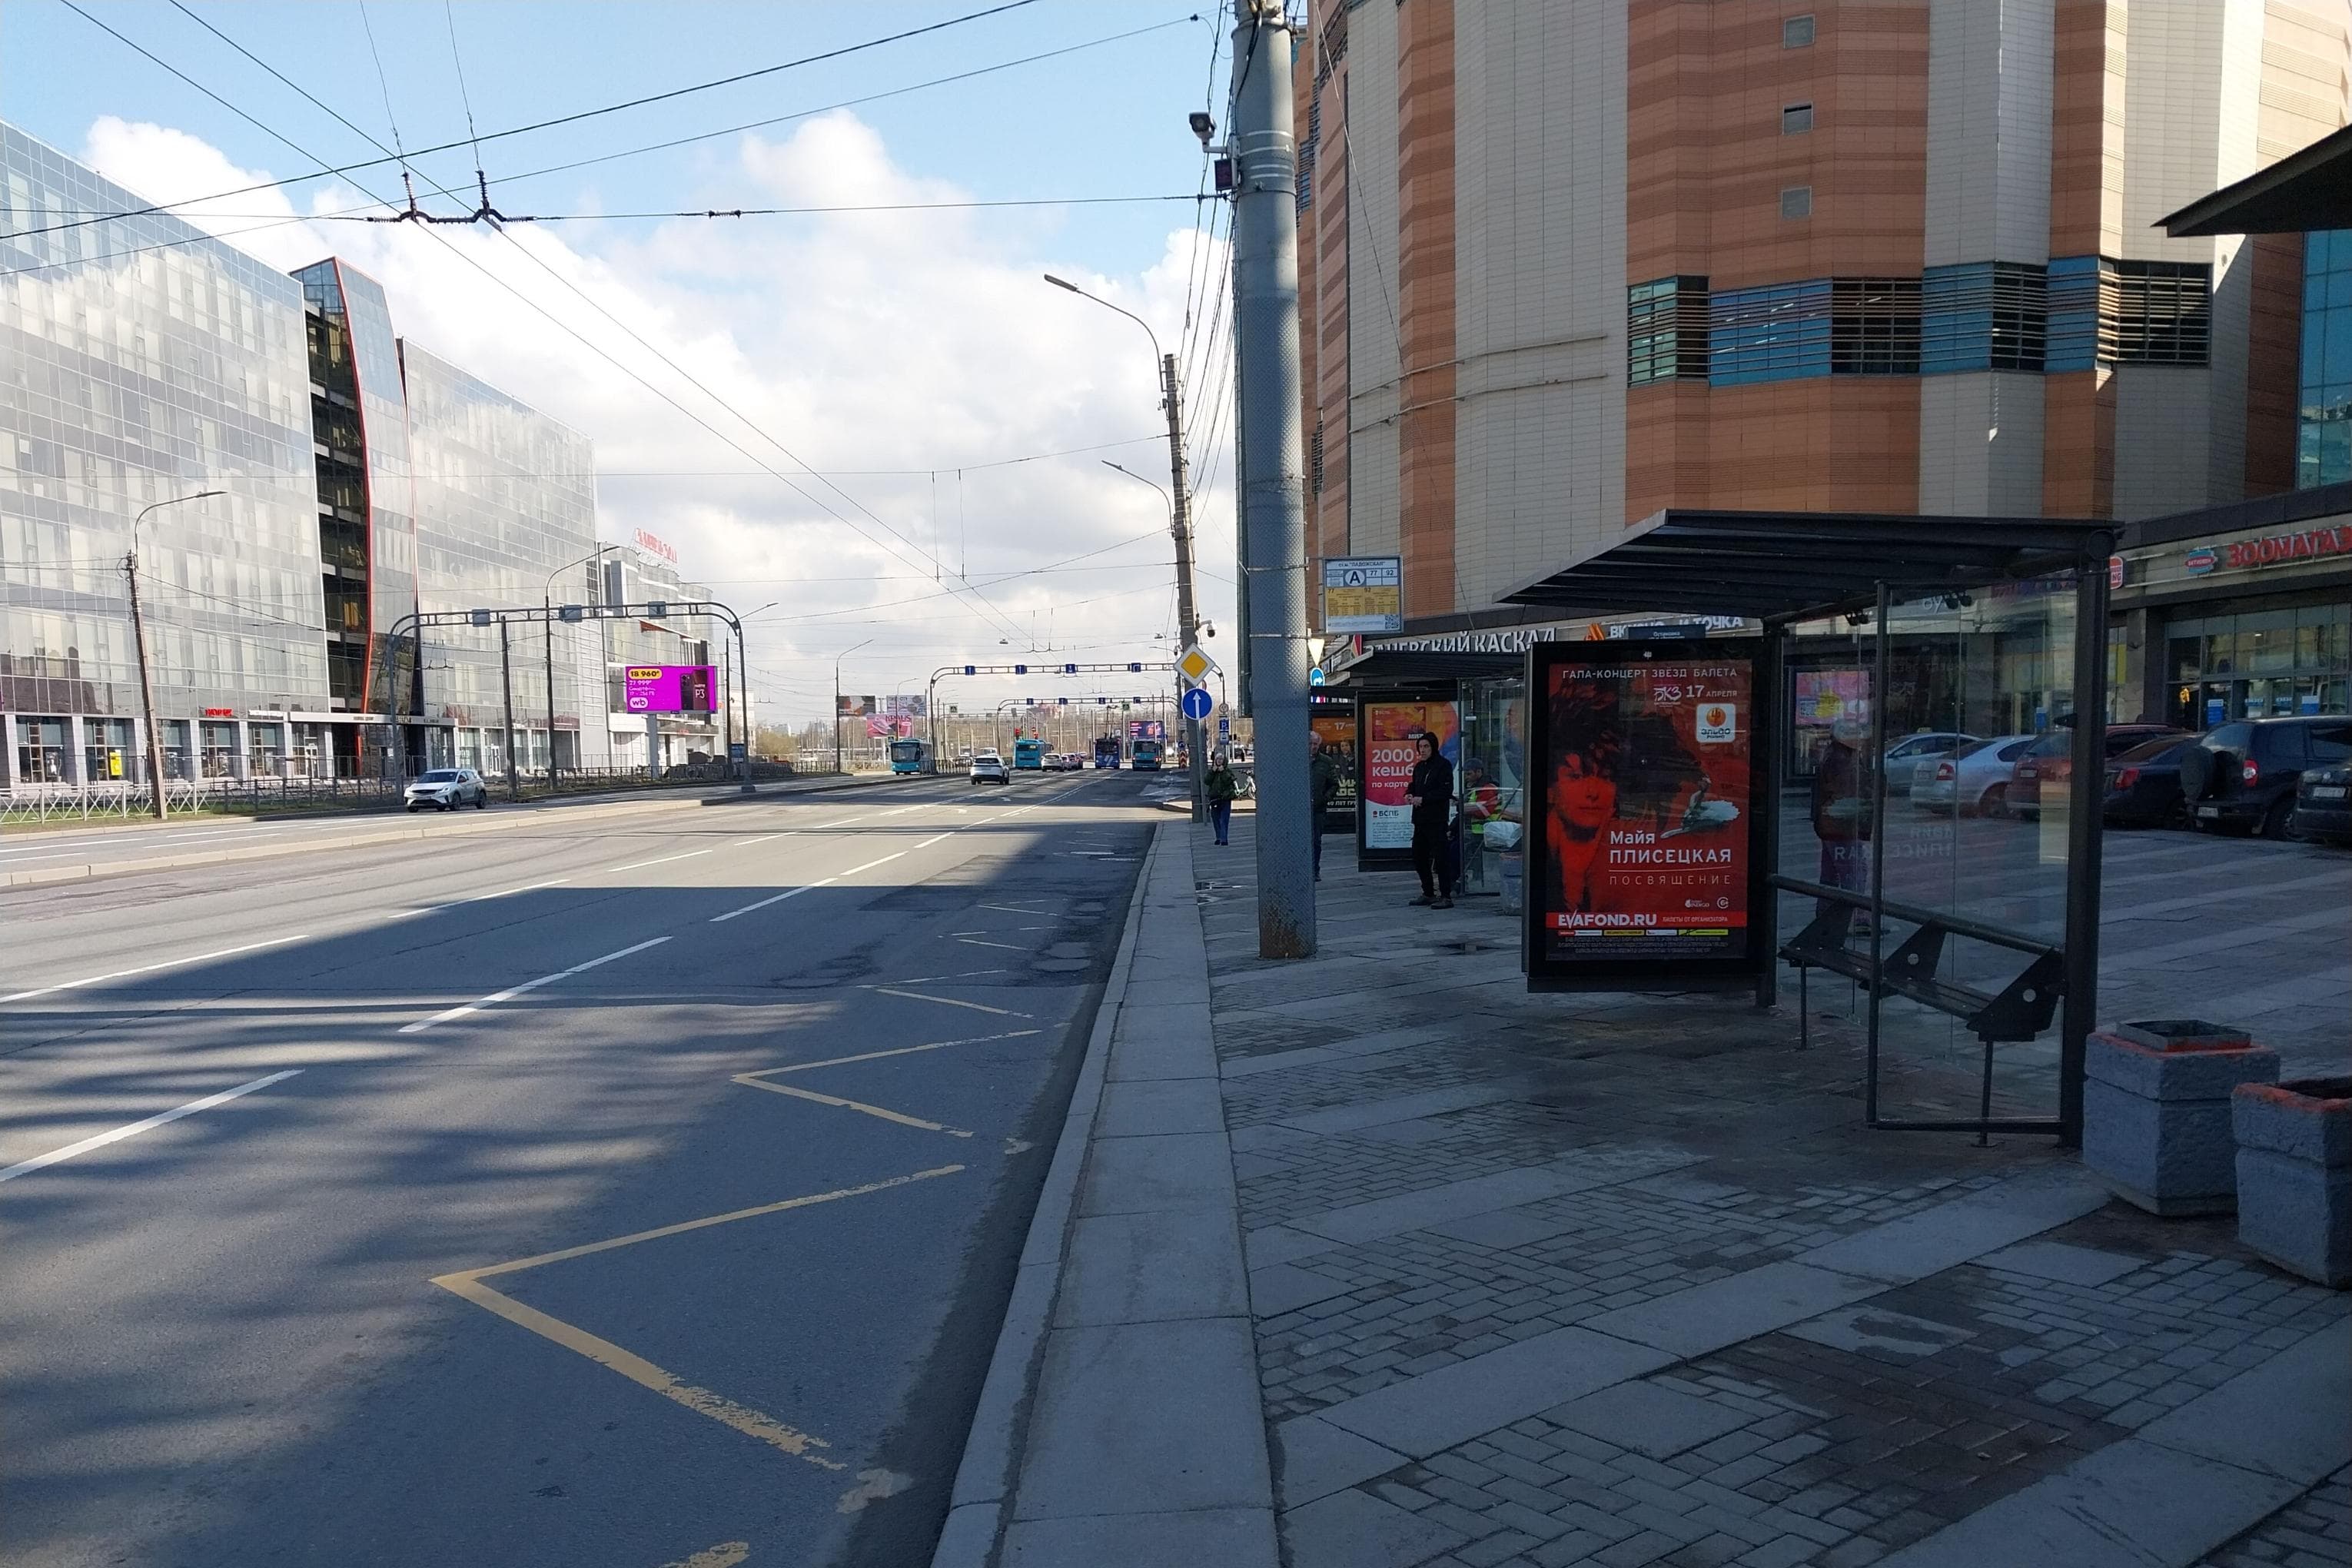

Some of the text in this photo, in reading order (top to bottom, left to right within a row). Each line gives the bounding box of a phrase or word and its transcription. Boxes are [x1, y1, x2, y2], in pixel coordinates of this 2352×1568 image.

[1563, 667, 1738, 679] ГАЛА-КОНЦЕРТ ЗВЁЗД БАЛЕТА
[1686, 685, 1705, 698] 17
[1371, 749, 1414, 763] 2000
[1372, 762, 1414, 776] кешб
[1384, 781, 1409, 789] карте
[1610, 830, 1655, 845] Майя
[1610, 849, 1731, 864] ПЛИСЕЦКАЯ
[1558, 910, 1656, 929] EVAFOND.RU
